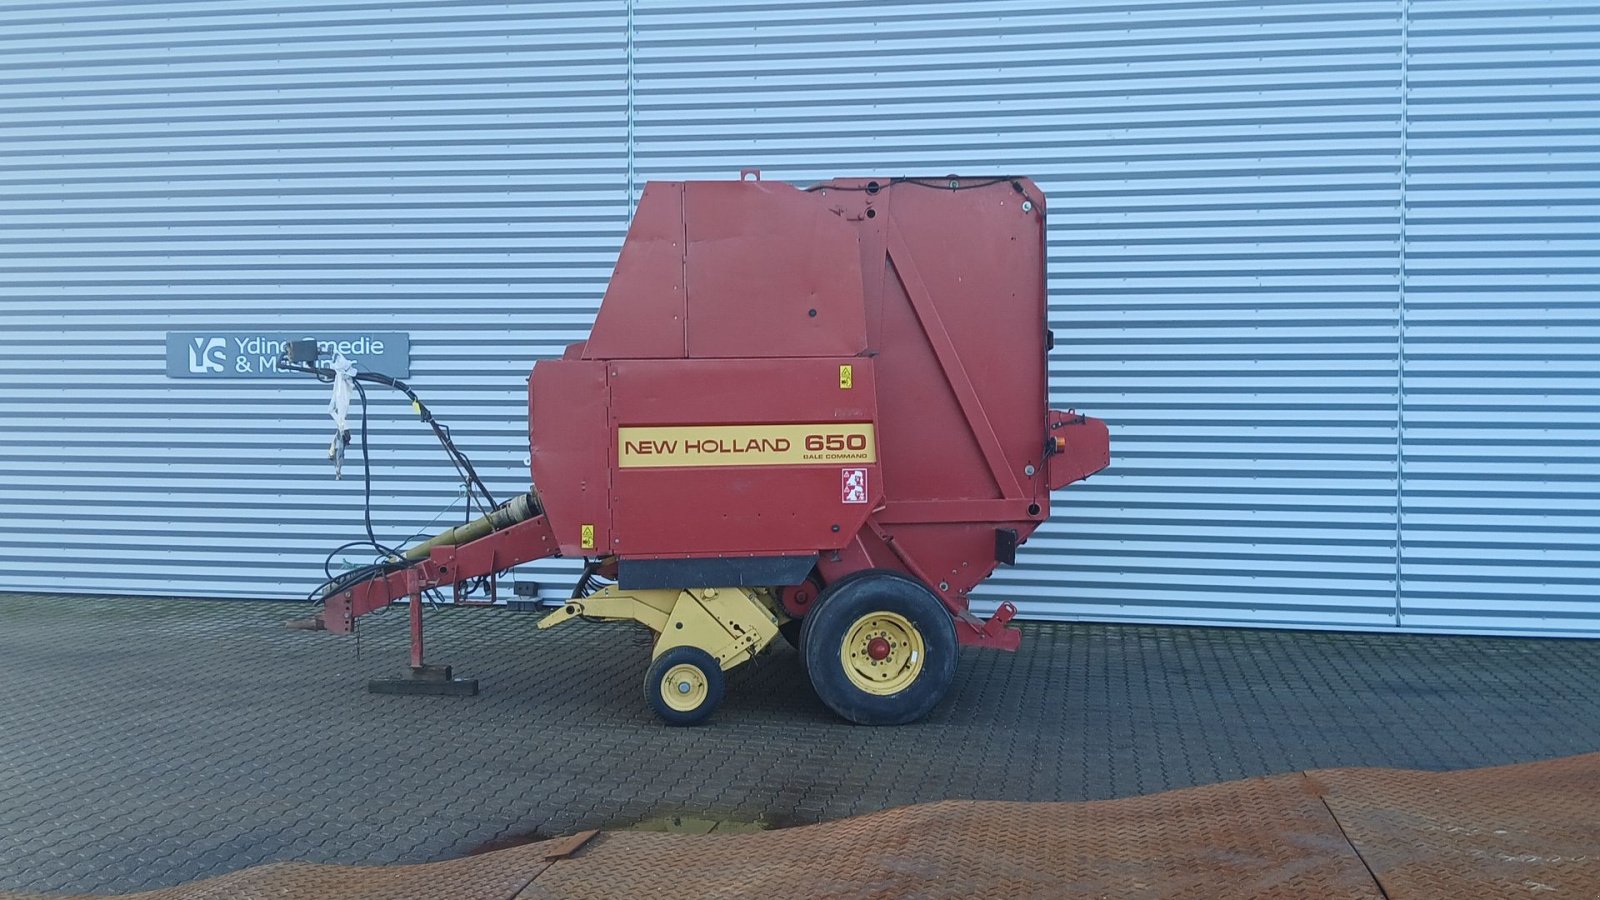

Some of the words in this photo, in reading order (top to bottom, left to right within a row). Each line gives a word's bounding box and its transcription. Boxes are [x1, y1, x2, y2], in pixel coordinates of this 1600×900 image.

[189, 337, 227, 373] YS
[302, 337, 384, 355] medie
[235, 355, 253, 373] &
[625, 440, 678, 455] NEW
[684, 438, 791, 454] HOLLAND
[804, 434, 867, 451] 650
